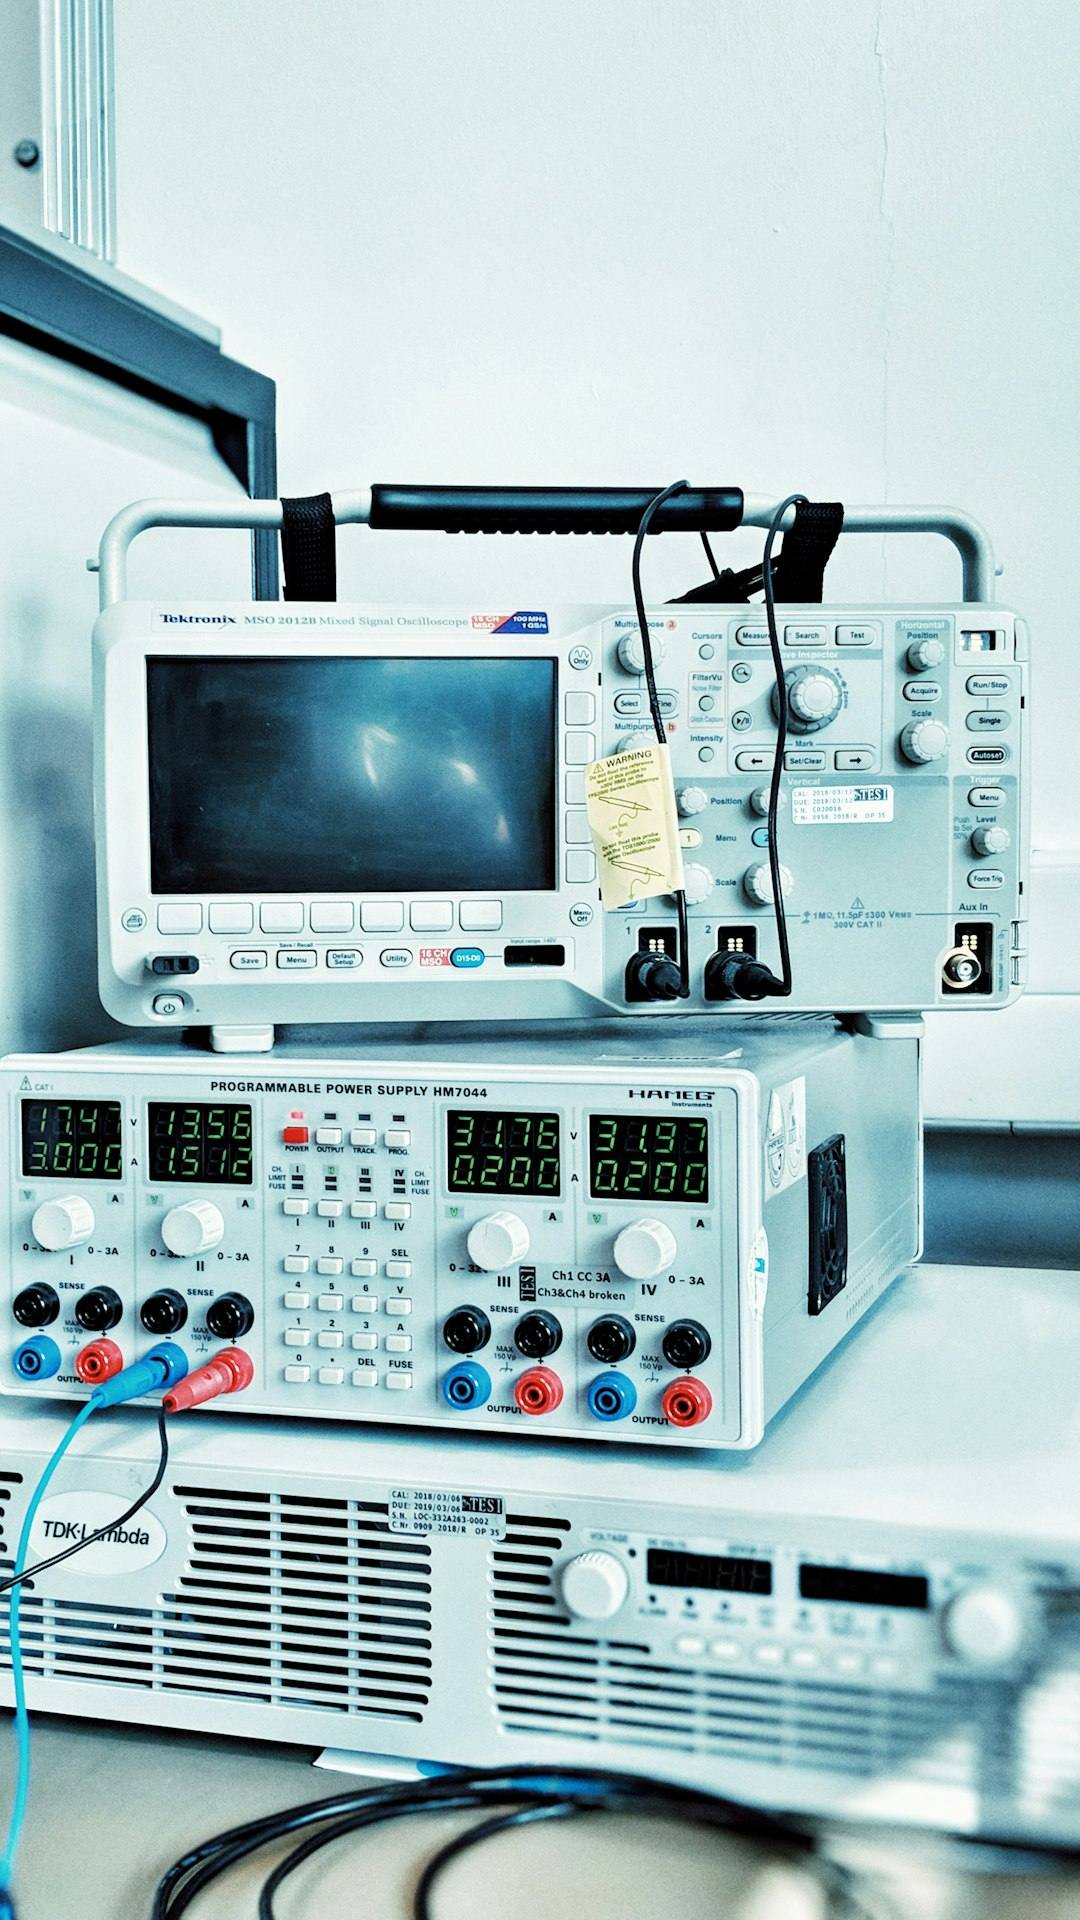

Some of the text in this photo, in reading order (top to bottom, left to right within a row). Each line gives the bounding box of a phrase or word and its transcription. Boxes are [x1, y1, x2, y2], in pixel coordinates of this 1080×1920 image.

[160, 614, 237, 624] Tektronix
[244, 616, 469, 628] MSO 2012B Mixed Signal Oscilloscope
[692, 632, 723, 640] Cursors
[907, 632, 938, 640] Position
[798, 651, 839, 660] Inspector
[573, 658, 589, 666] Only
[912, 710, 932, 718] Scale
[979, 716, 1001, 725] Single
[614, 723, 656, 732] Multipurpo
[690, 736, 724, 744] Intensity
[795, 740, 814, 748] Mark
[606, 750, 653, 768] WARNING
[973, 752, 1002, 760] Autoset
[789, 757, 822, 766] Set/Clear
[787, 778, 820, 786] Vertical
[970, 776, 1001, 784] Trigger
[710, 798, 742, 806] Position
[716, 834, 736, 842] Menu
[716, 878, 736, 886] Scale
[992, 876, 1002, 884] Trig
[958, 903, 988, 912] Aux In
[704, 925, 712, 934] 2
[420, 949, 448, 958] 16 CH
[386, 954, 408, 964] Utility
[420, 958, 442, 966] MSO
[210, 1082, 488, 1098] PROGRAMMABLE POWER SUPPLY HM7044
[629, 1089, 716, 1100] HAMEG
[130, 1119, 138, 1127] V
[168, 1109, 250, 1140] 13.56
[453, 1116, 558, 1150] 31.76
[570, 1132, 578, 1140] V
[596, 1120, 707, 1154] 31.97
[29, 1142, 122, 1172] 3.000
[168, 1146, 252, 1177] 1.512
[131, 1158, 138, 1166] A
[394, 1169, 404, 1177] IV
[452, 1154, 560, 1189] 0.200
[570, 1174, 578, 1182] A
[595, 1159, 707, 1194] 0.200
[111, 1194, 120, 1204] A
[242, 1200, 250, 1208] A
[548, 1212, 557, 1222] A
[328, 1220, 335, 1228] II
[360, 1222, 370, 1230] III
[394, 1223, 405, 1231] IV
[696, 1220, 704, 1228] A
[329, 1246, 334, 1254] 8
[391, 1249, 408, 1257] SEL
[196, 1260, 205, 1272] II
[552, 1270, 611, 1283] Ch1 CC 3A
[58, 1282, 85, 1290] SENSE
[329, 1282, 334, 1290] 5
[498, 1276, 511, 1288] III
[187, 1288, 214, 1297] SENSE
[363, 1284, 369, 1292] 6
[397, 1286, 404, 1294] V
[640, 1284, 657, 1296] IV
[538, 1288, 626, 1301] Ch3&Ch4 broken
[490, 1304, 519, 1314] SENSE
[634, 1314, 665, 1323] SENSE
[363, 1321, 369, 1329] 3
[496, 1345, 514, 1353] MAX
[296, 1354, 302, 1362] 0
[494, 1352, 507, 1360] 150
[358, 1358, 376, 1366] DEL
[388, 1360, 414, 1369] FUSE
[639, 1362, 663, 1371] 150 Vp
[57, 1375, 88, 1384] OUTPU
[487, 1404, 522, 1414] OUTPUT
[632, 1416, 669, 1426] OUTPUT
[392, 1490, 460, 1503] CAL: 2018/03/06
[392, 1500, 460, 1513] DUE: 2019/03/06
[392, 1512, 408, 1520] S.N.
[438, 1524, 467, 1534] 2018/R
[475, 1527, 487, 1536] OP
[490, 1528, 500, 1536] 35
